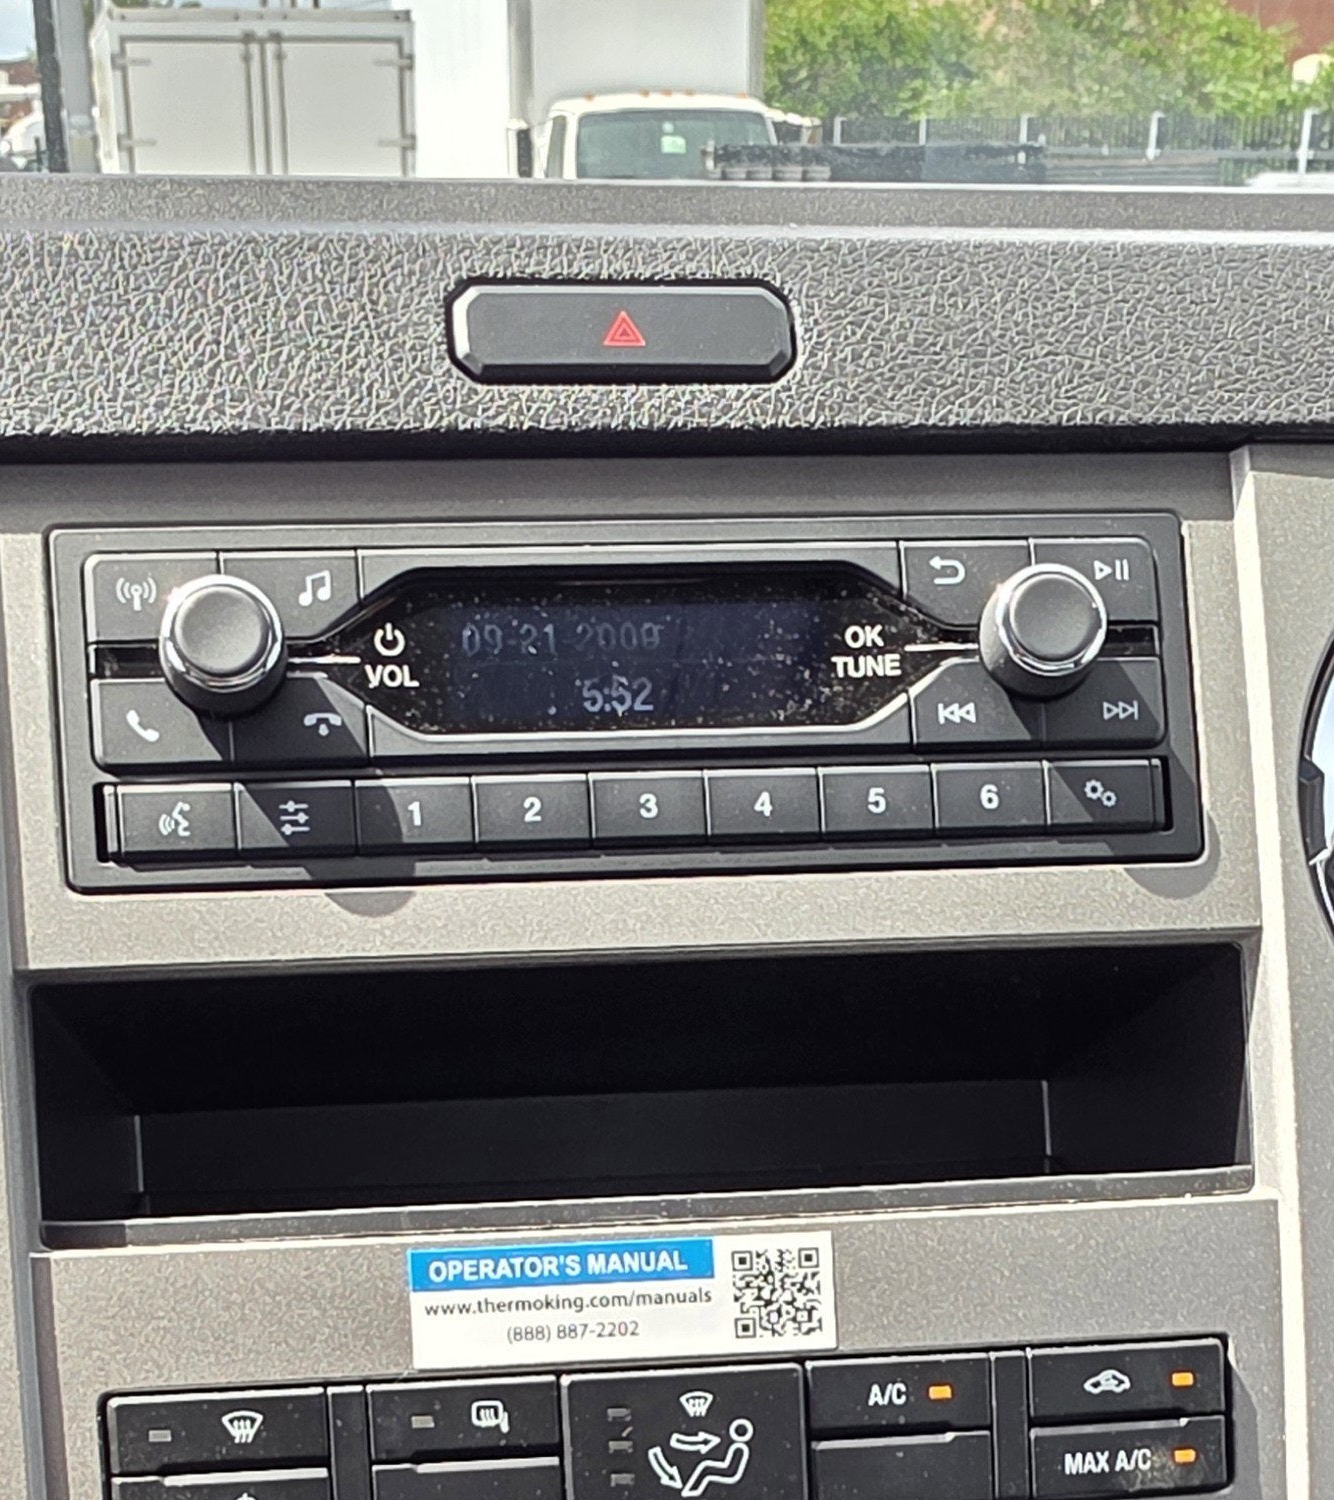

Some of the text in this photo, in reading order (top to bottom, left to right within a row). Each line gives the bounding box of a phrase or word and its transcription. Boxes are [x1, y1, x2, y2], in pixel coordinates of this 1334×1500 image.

[844, 624, 885, 649] OK
[364, 664, 420, 689] VOL
[831, 655, 903, 678] TUNE
[581, 674, 655, 714] 5:52
[523, 797, 542, 823] 2
[639, 793, 659, 819] 3
[754, 791, 774, 817] 4
[868, 787, 887, 813] 5
[981, 784, 1000, 810] 6
[407, 801, 423, 826] 1
[427, 1249, 688, 1283] OPERATOR'S MANUAL
[424, 1288, 713, 1316] www.thermoking.com/manuals
[506, 1320, 640, 1343] (888) 887-2202
[867, 1382, 907, 1406] A/C
[1064, 1448, 1153, 1475] MAX A/C
